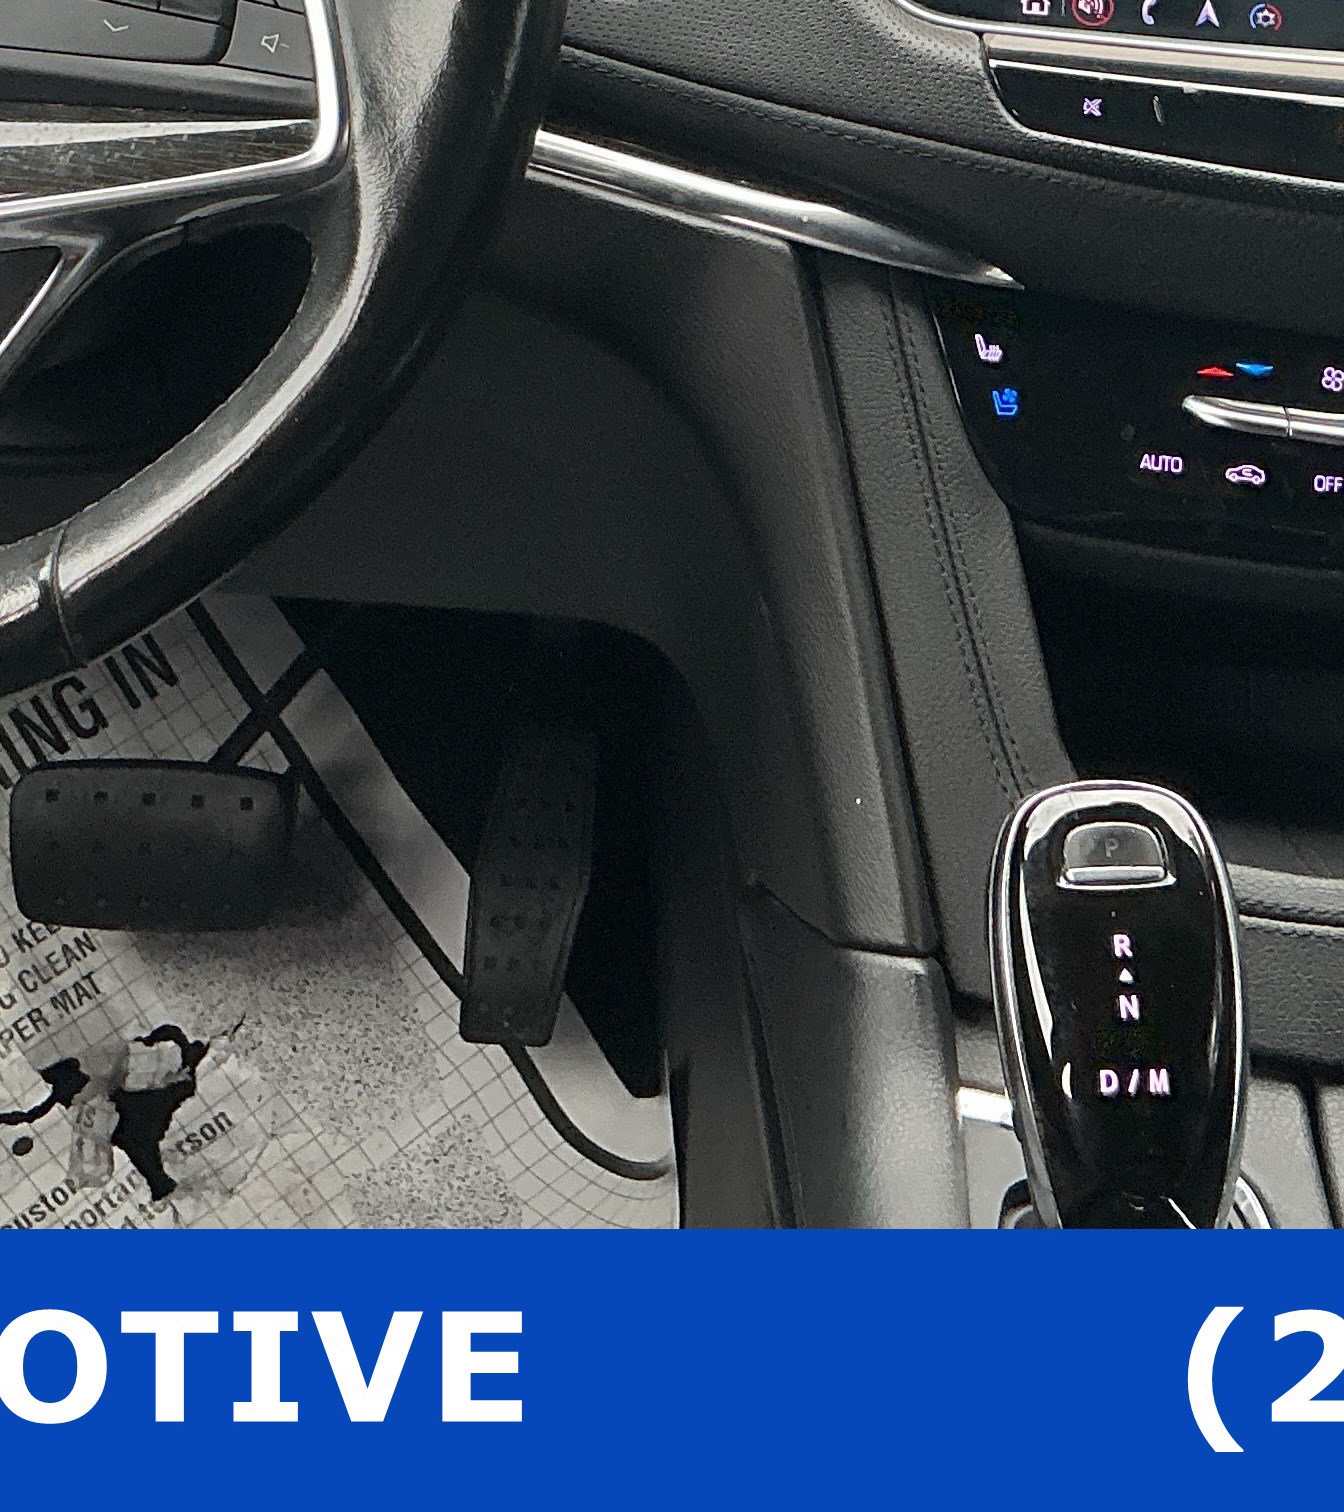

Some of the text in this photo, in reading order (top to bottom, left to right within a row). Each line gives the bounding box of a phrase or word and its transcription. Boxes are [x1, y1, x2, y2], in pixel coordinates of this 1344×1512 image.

[1139, 453, 1183, 474] AUTO
[1313, 474, 1344, 494] OFF
[105, 633, 180, 710] IN
[1113, 933, 1134, 959] R
[17, 930, 97, 993] CLEAN
[49, 970, 102, 1019] MAT
[1118, 994, 1141, 1021] N
